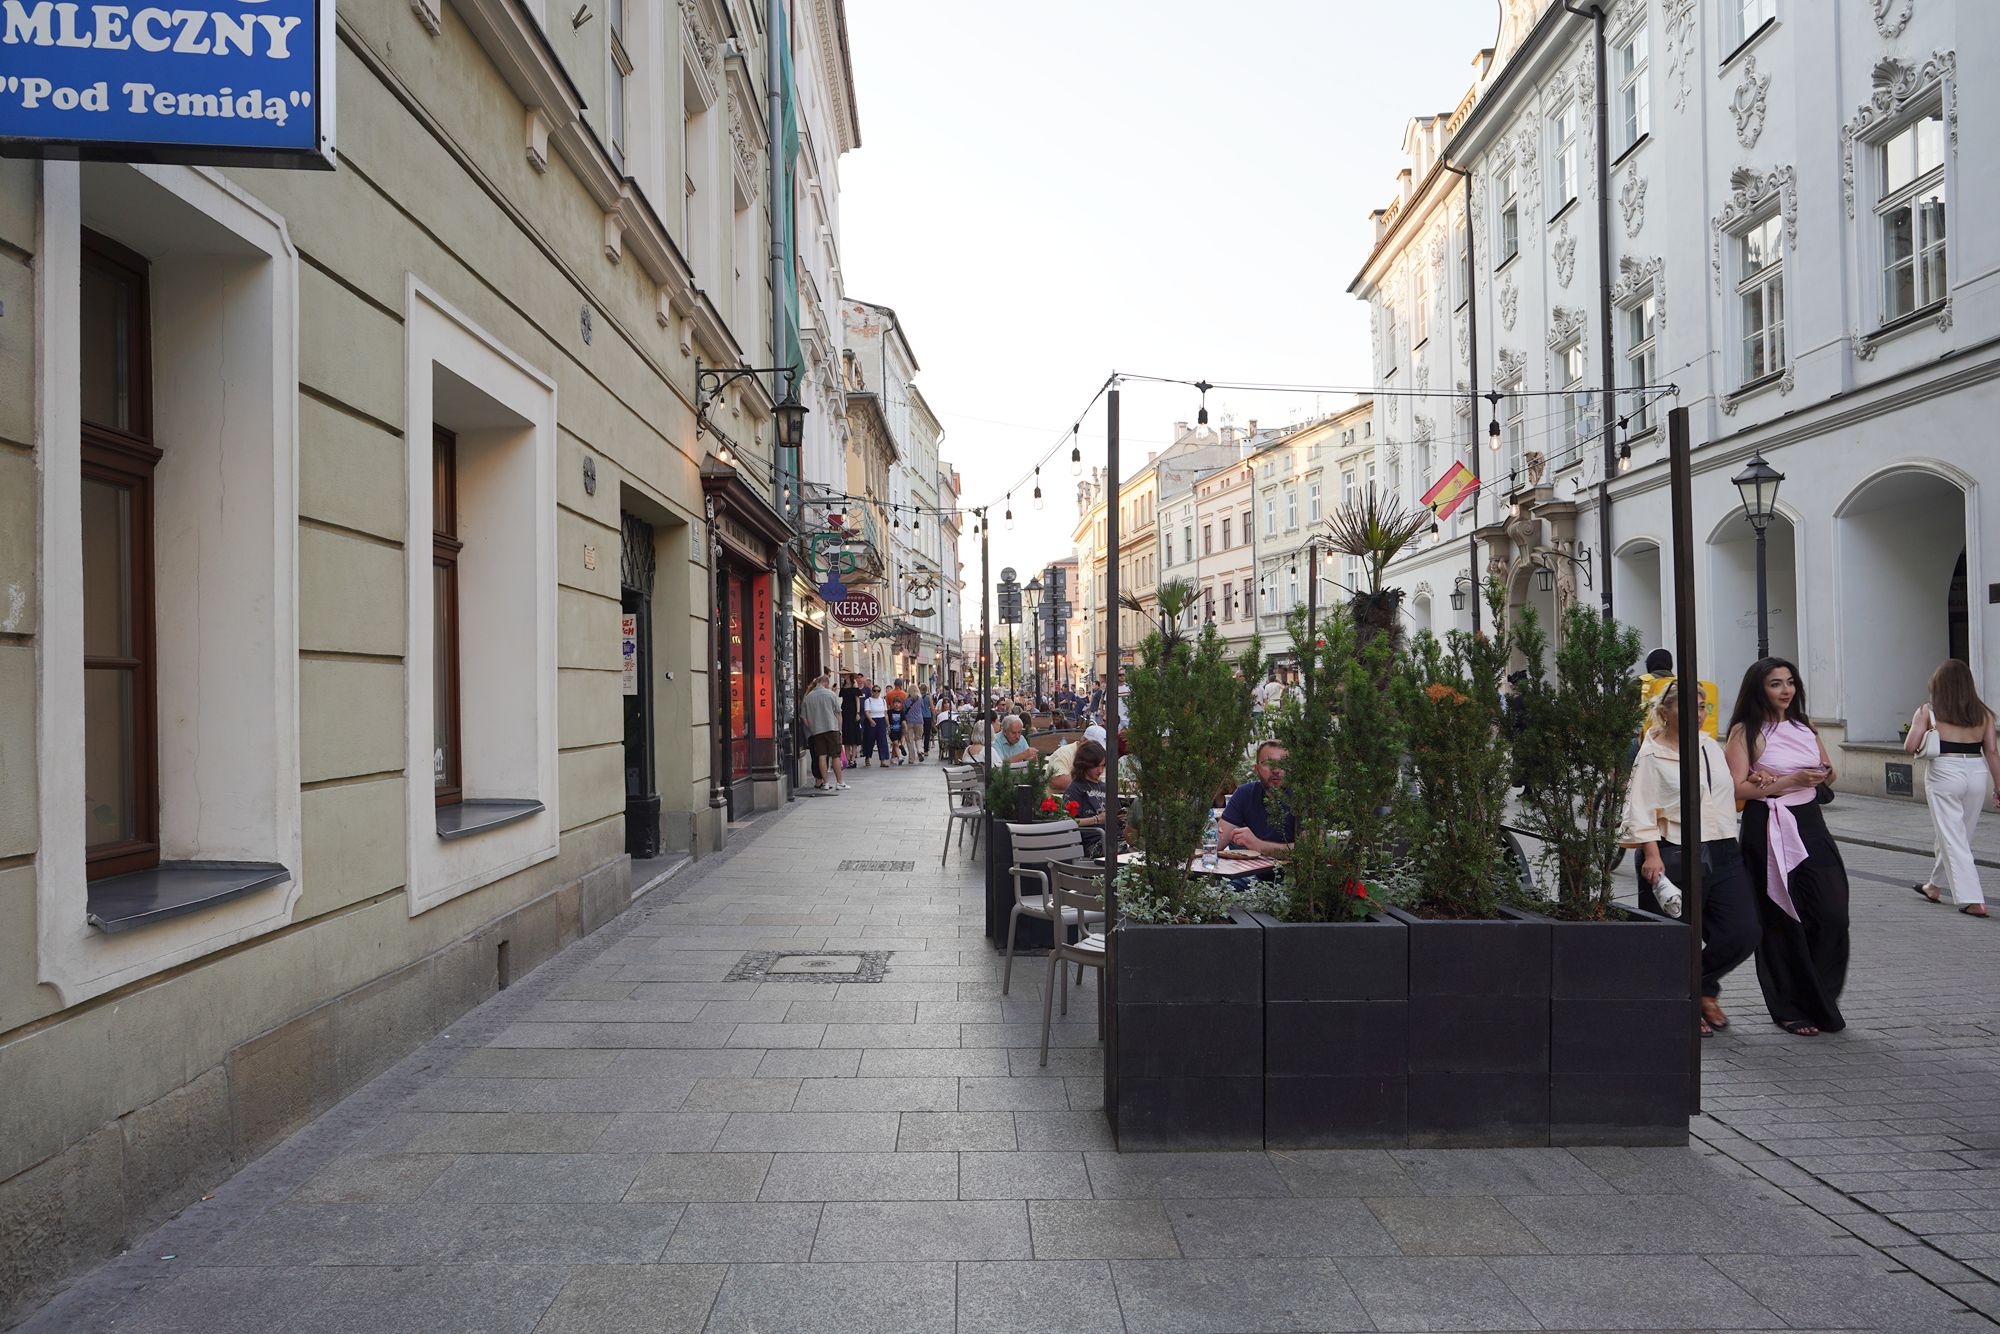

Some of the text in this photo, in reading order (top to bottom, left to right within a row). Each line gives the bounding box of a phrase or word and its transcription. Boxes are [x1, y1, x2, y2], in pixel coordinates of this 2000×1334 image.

[1, 0, 302, 59] MLECZNY
[122, 82, 312, 127] Temidą"
[834, 601, 878, 616] KEBAB
